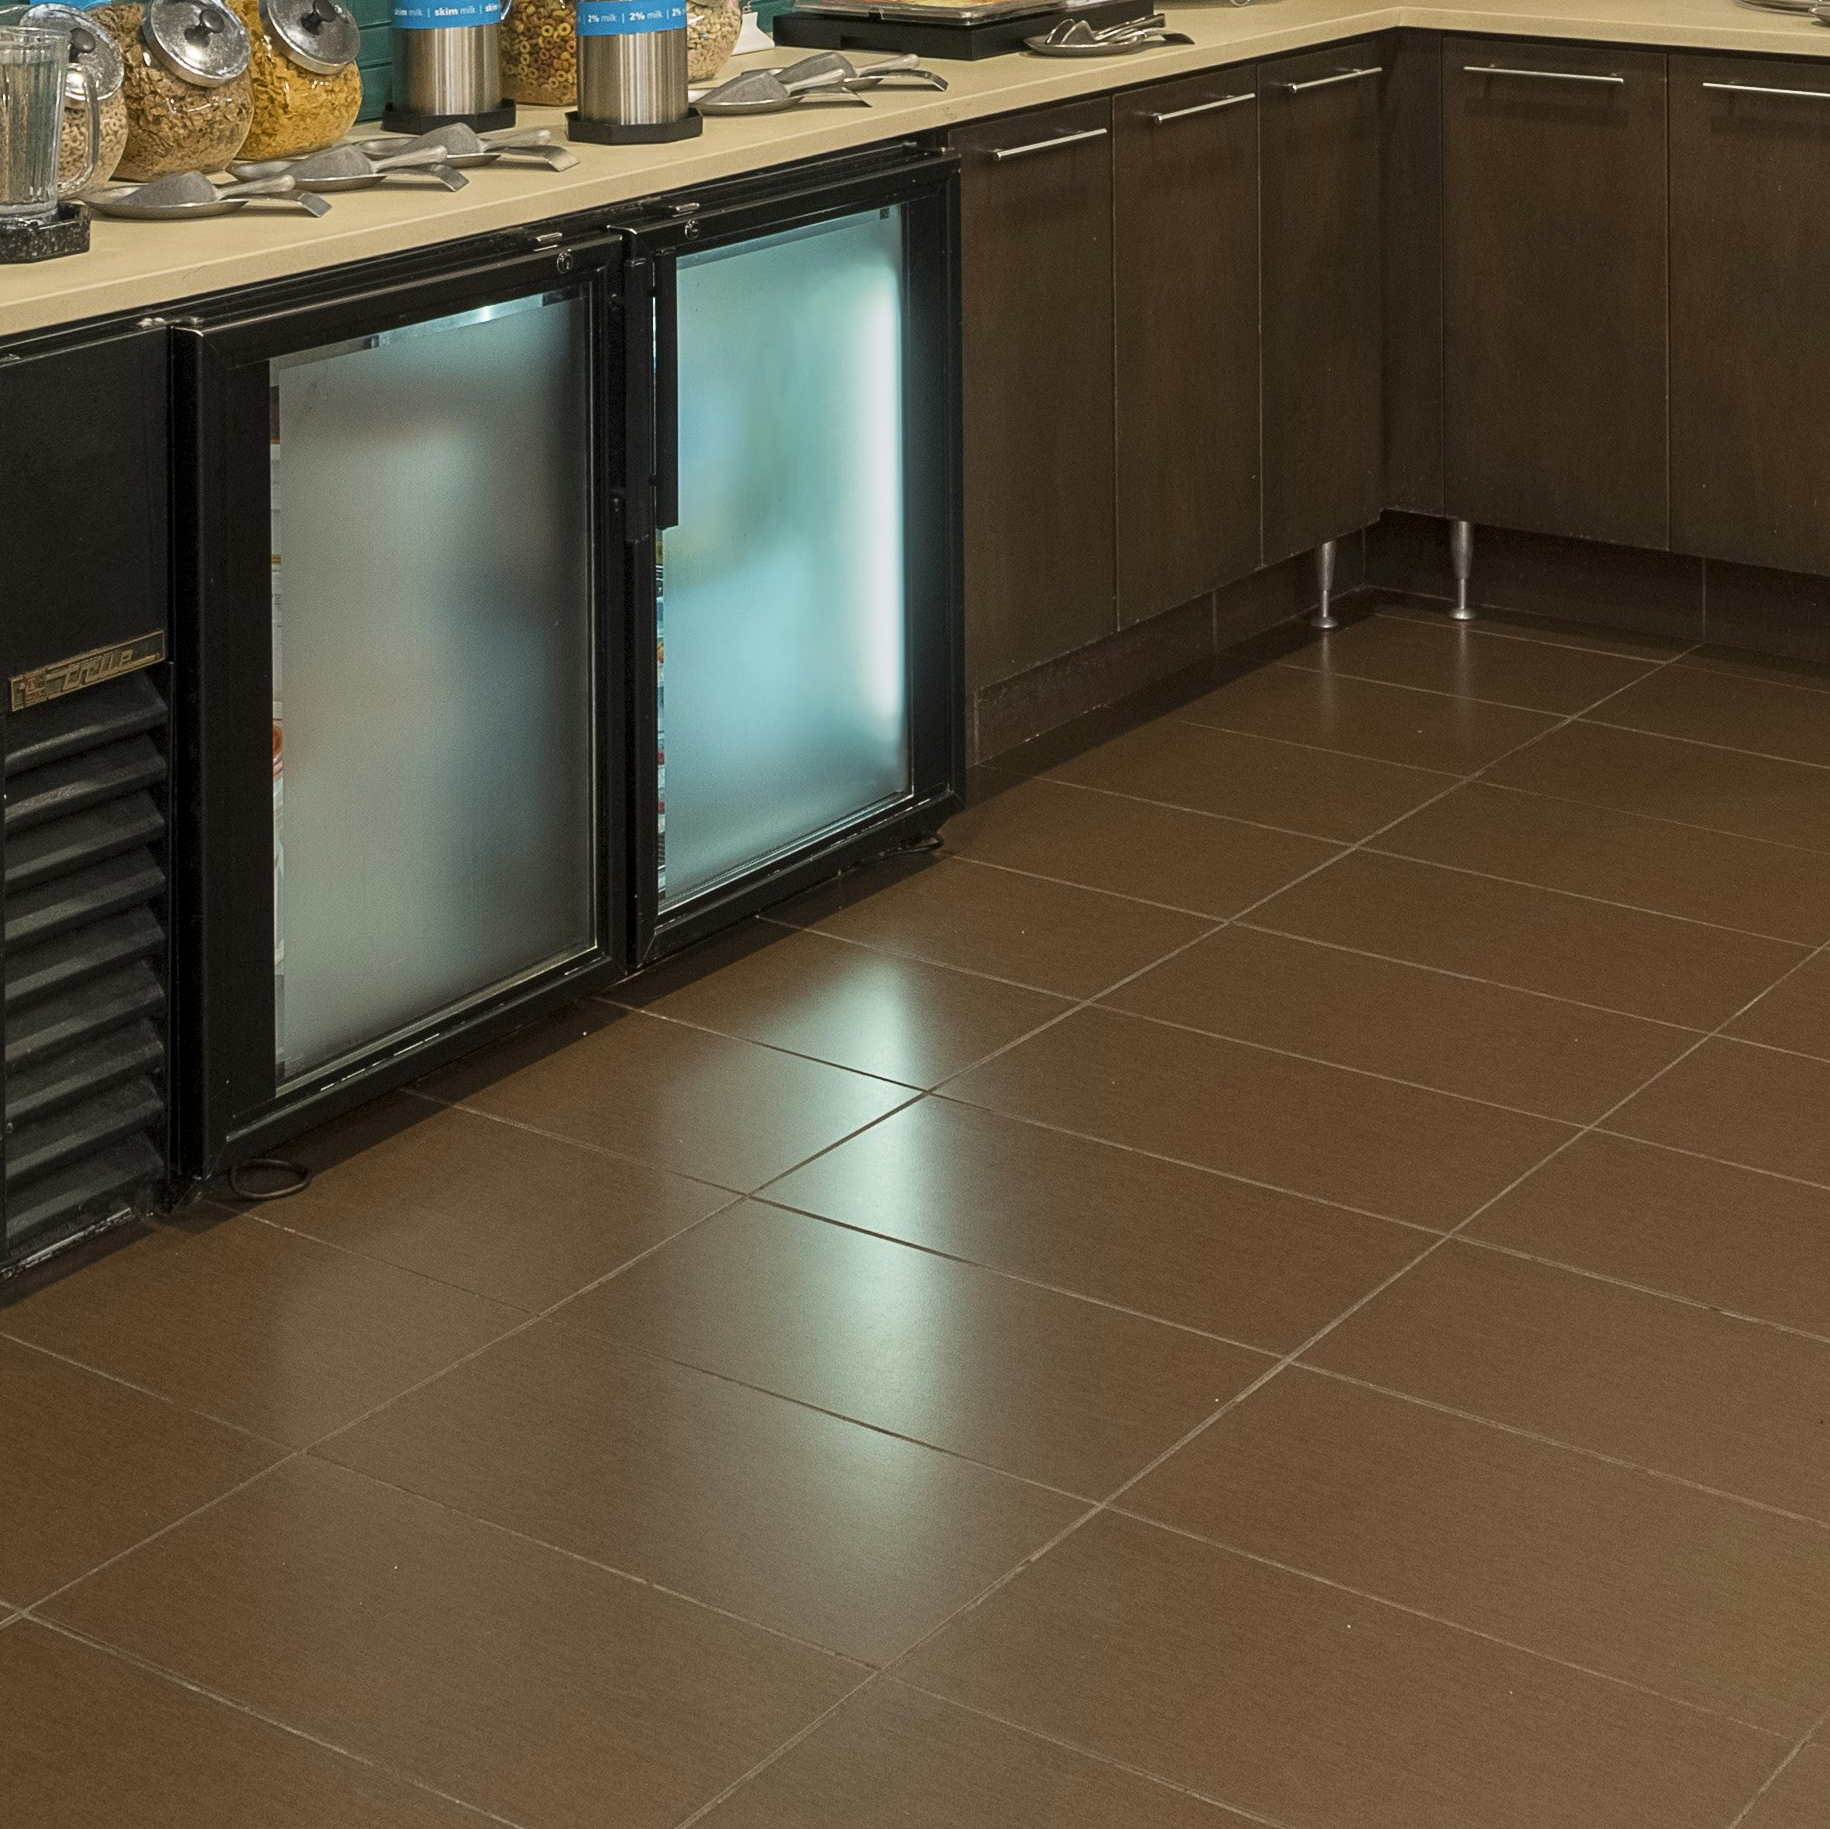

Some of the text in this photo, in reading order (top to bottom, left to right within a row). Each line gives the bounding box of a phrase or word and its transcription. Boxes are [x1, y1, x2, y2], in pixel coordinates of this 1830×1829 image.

[434, 7, 459, 17] skim
[460, 5, 476, 15] milk
[629, 11, 646, 21] 2%
